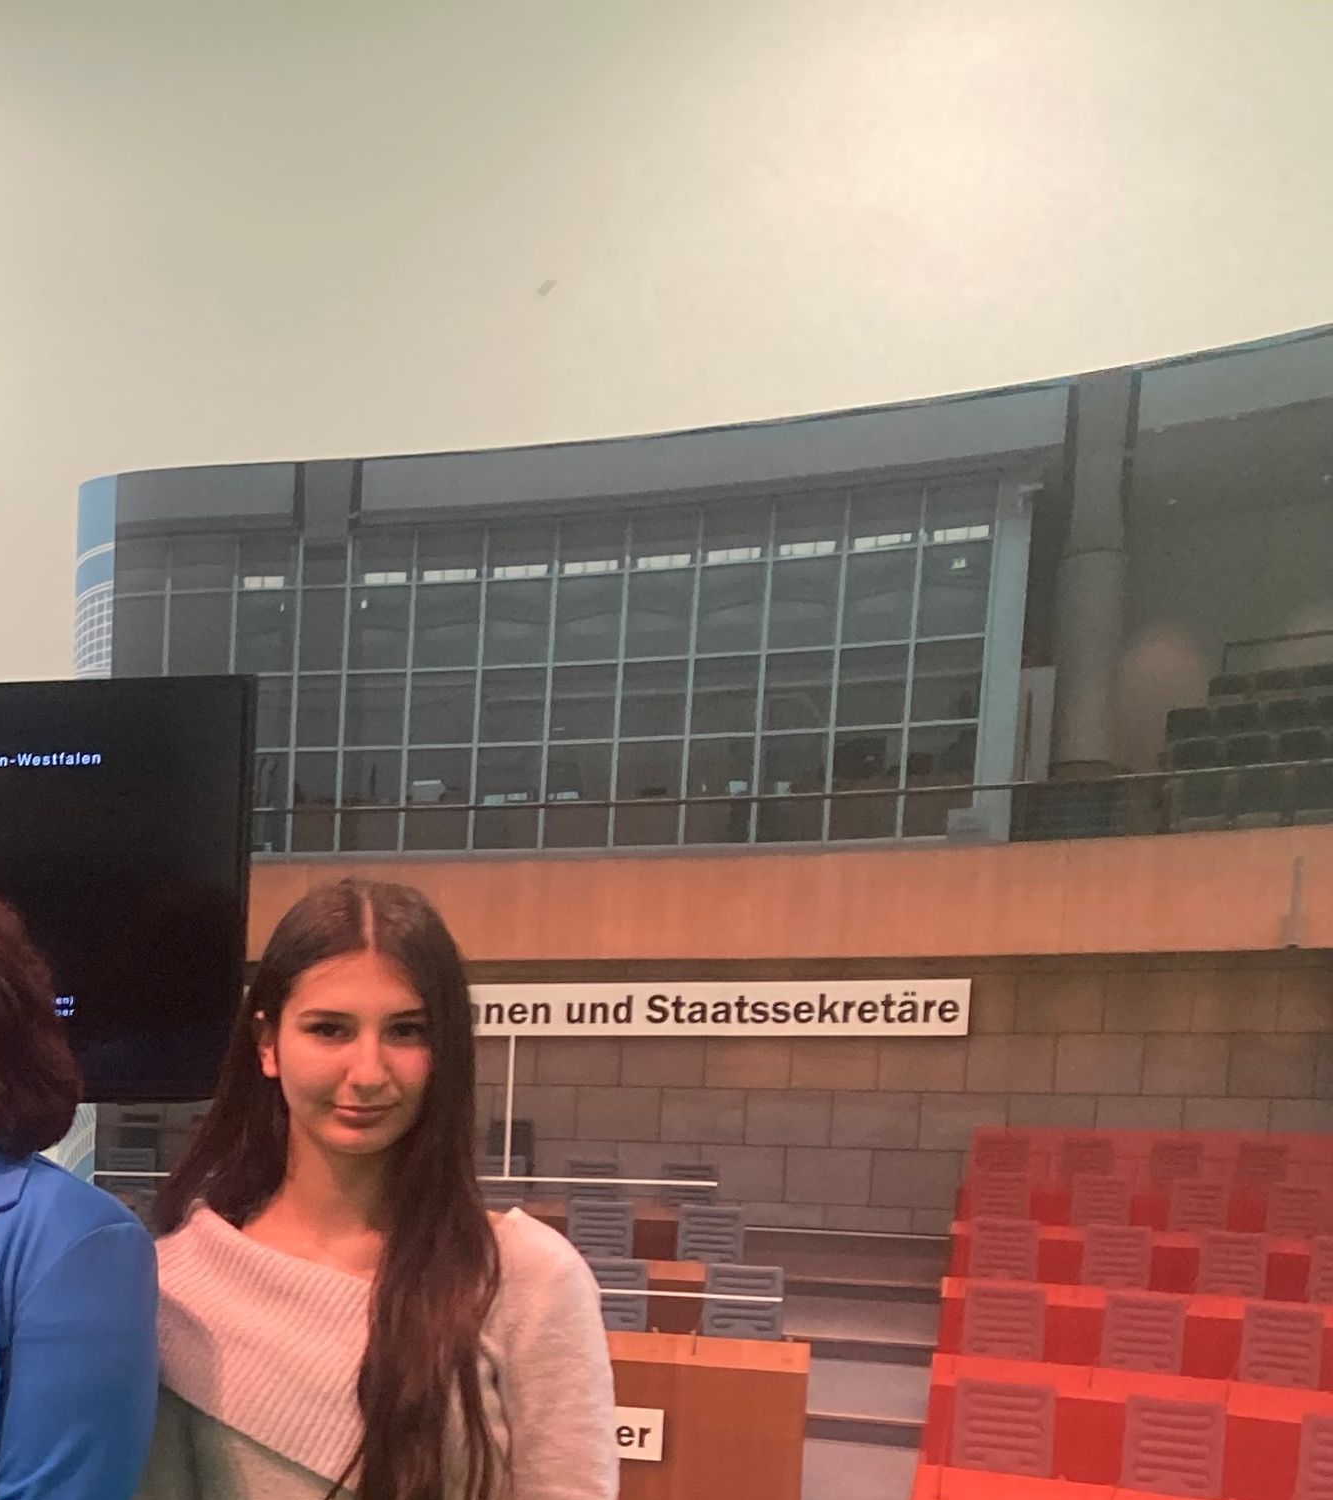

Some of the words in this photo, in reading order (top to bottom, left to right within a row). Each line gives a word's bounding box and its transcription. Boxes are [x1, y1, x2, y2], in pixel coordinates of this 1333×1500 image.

[566, 994, 633, 1026] und
[645, 992, 961, 1026] Staatssekretäre
[615, 1424, 652, 1449] er
